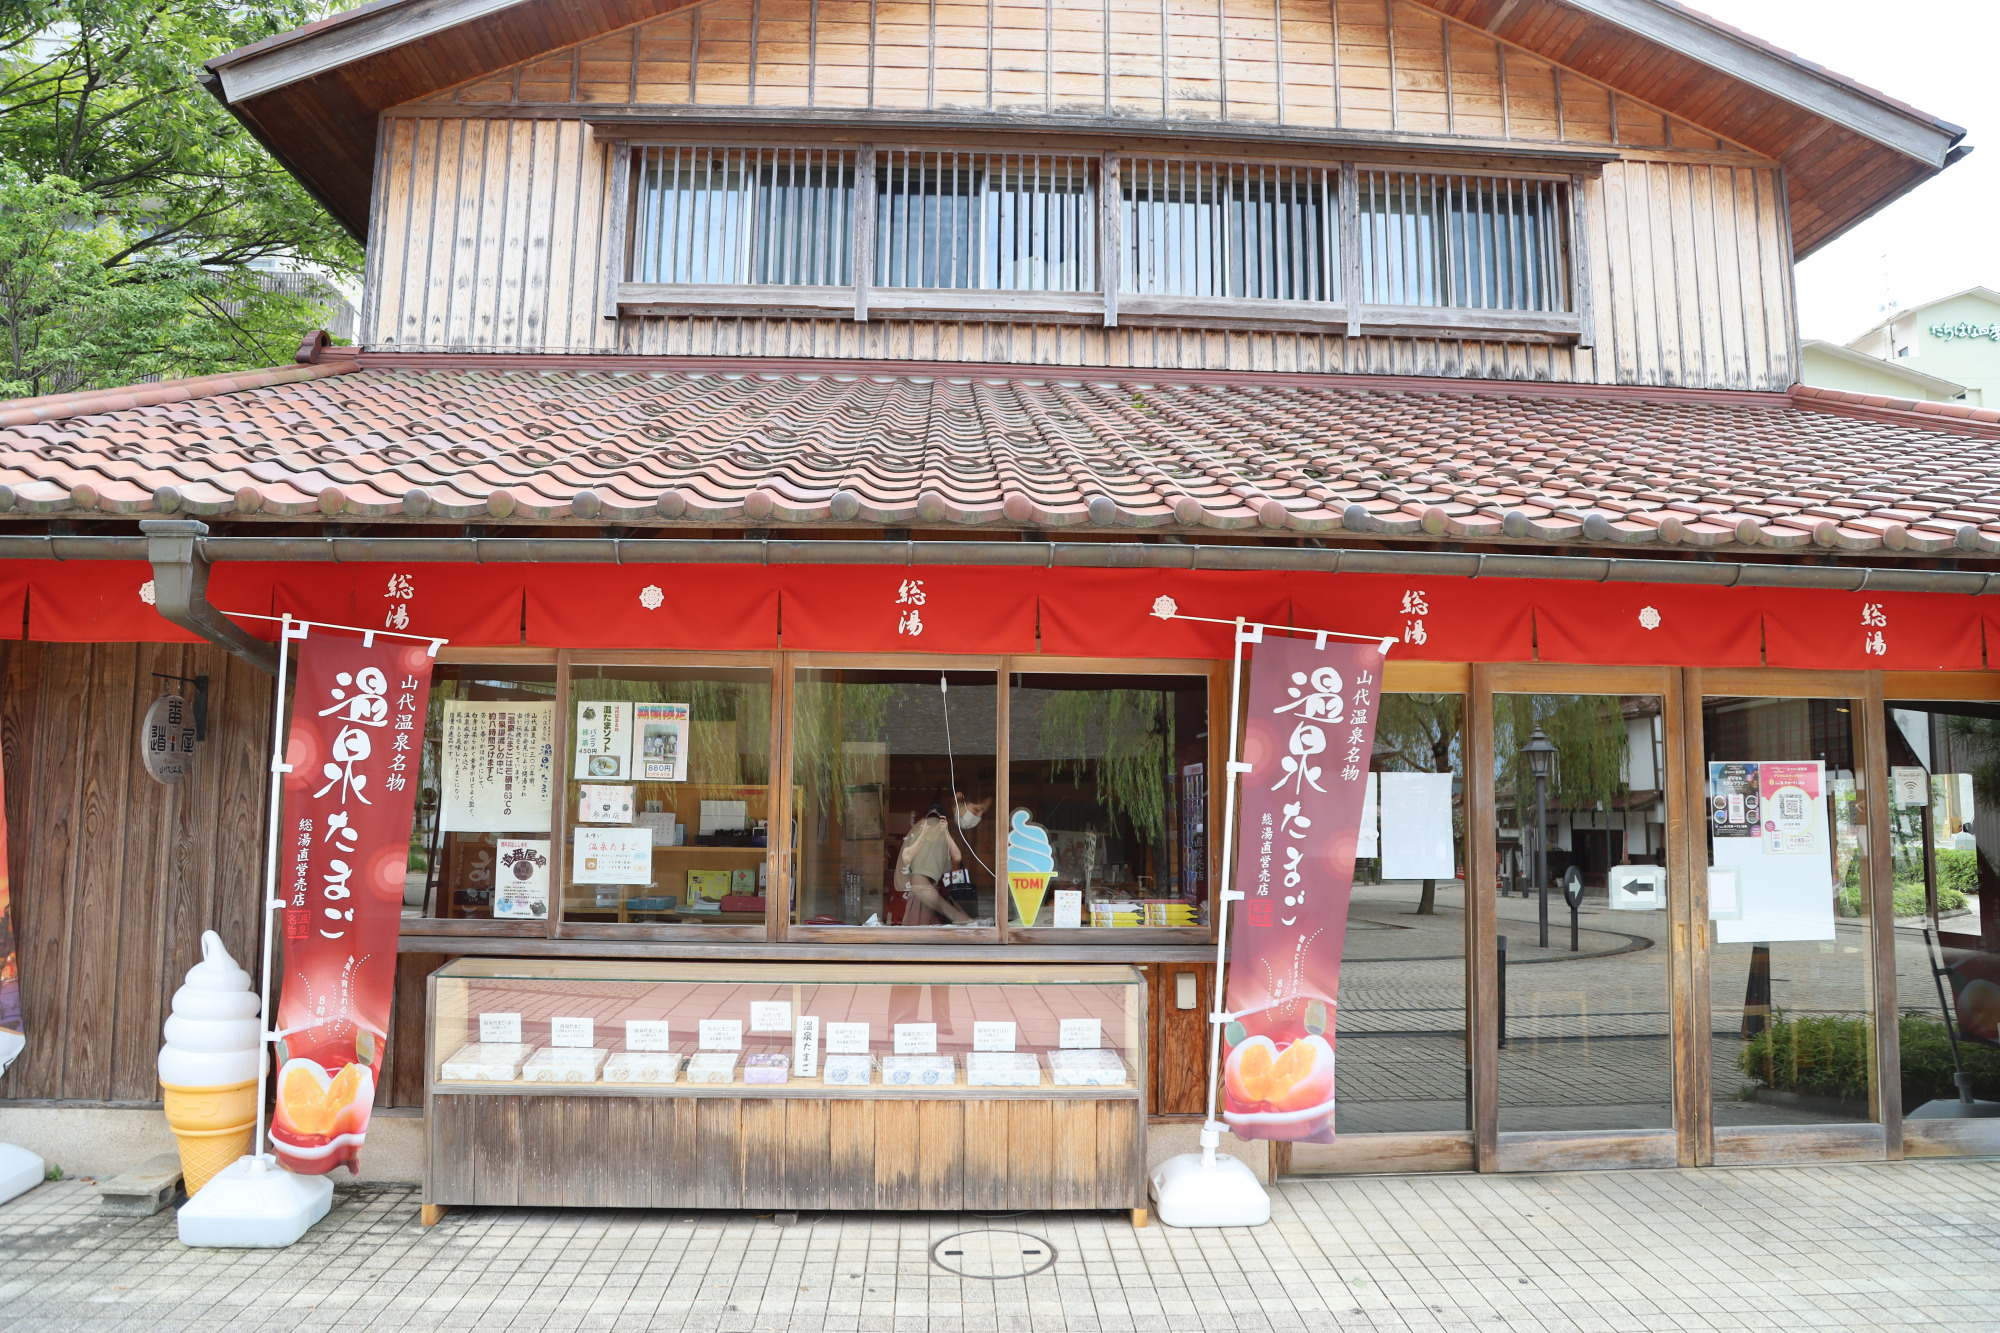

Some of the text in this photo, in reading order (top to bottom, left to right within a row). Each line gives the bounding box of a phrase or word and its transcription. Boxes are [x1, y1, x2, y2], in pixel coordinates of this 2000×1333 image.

[384, 573, 414, 630] 総湯
[895, 579, 926, 636] 総湯
[1400, 590, 1429, 645] 総湯
[1861, 603, 1887, 656] 総湯
[385, 675, 419, 792] 山代温泉名物
[603, 705, 612, 753] 温たまソフト
[636, 705, 688, 721] 期間限定
[1340, 670, 1373, 781] 山代温泉名物
[648, 764, 671, 772] 880円
[313, 667, 388, 939] 温泉たまご
[1271, 667, 1344, 926] 温泉たまご
[291, 818, 313, 906] 総湯直営売店
[588, 842, 638, 851] 温泉たまご
[1256, 813, 1273, 896] 総湯直営売店
[1012, 878, 1044, 891] TOMI
[315, 996, 326, 1027] 8時間
[802, 1020, 813, 1072] 温泉たまご
